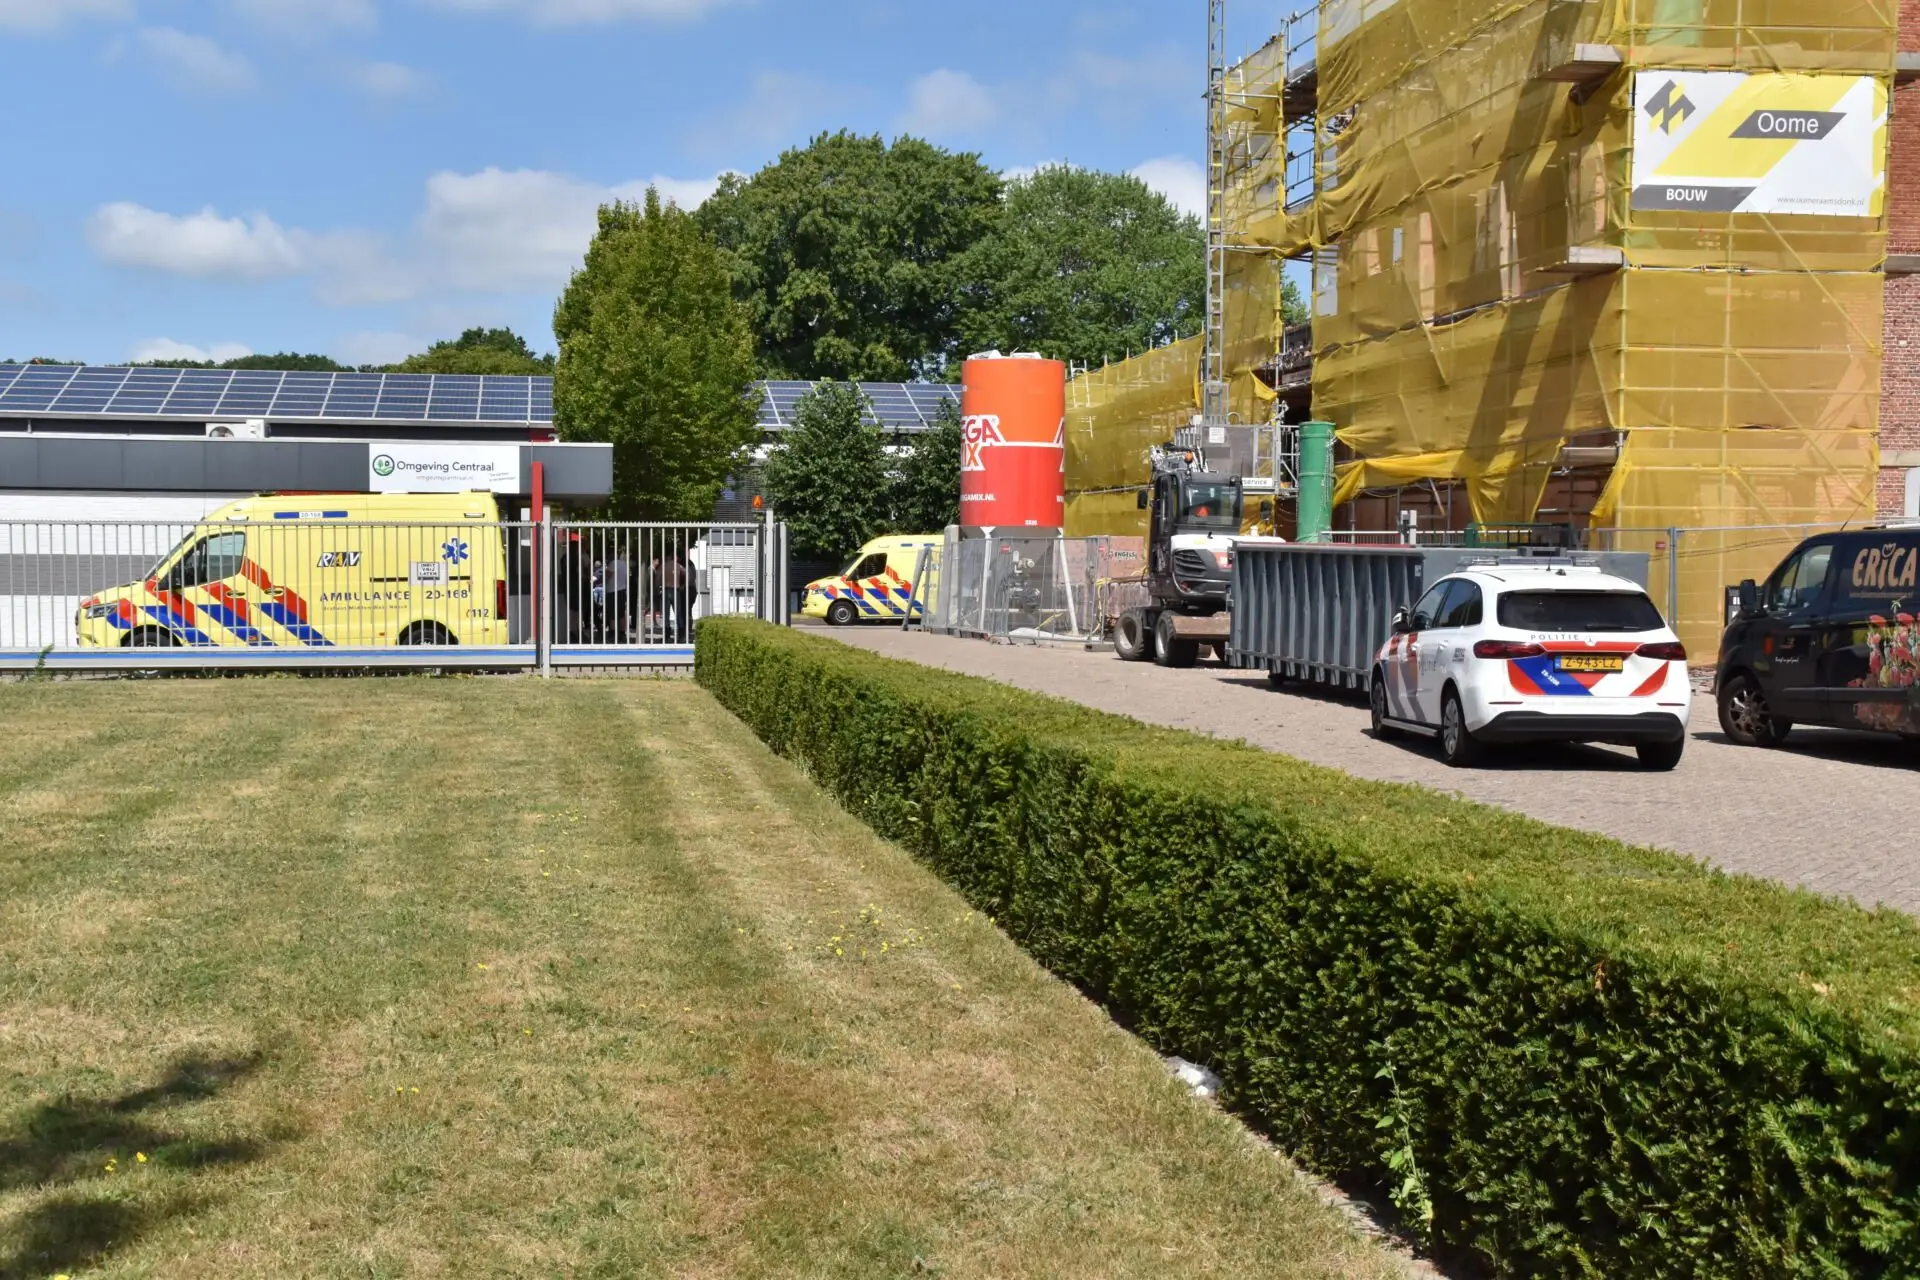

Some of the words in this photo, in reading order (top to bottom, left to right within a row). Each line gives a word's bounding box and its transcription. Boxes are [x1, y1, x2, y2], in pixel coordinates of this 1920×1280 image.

[1757, 112, 1819, 134] Oome
[1665, 188, 1708, 202] BOUW
[396, 460, 449, 472] Omgeving
[452, 461, 494, 472] Centraal
[317, 551, 361, 567] RAV
[320, 591, 411, 602] AMBULANCE
[425, 589, 469, 600] 20-168
[472, 609, 489, 618] 112
[1530, 634, 1580, 642] POLITIE
[1565, 656, 1617, 669] Z-943-LZ
